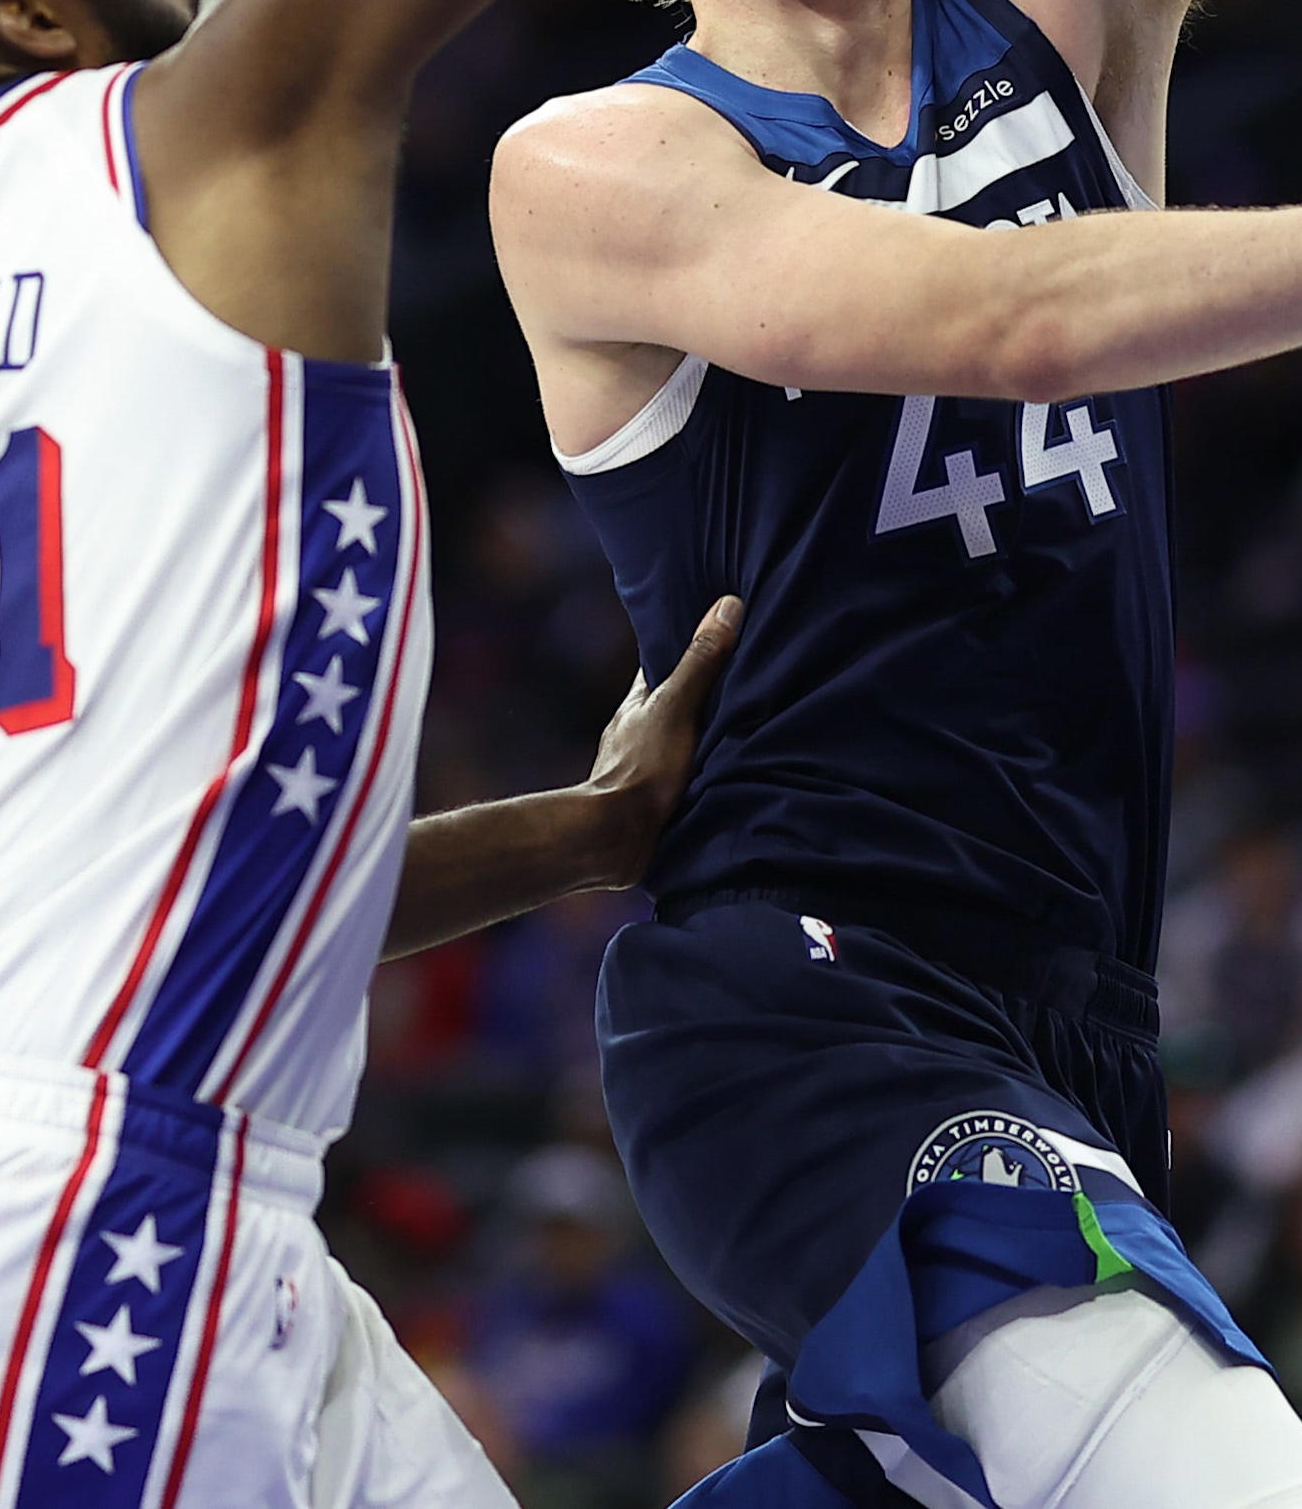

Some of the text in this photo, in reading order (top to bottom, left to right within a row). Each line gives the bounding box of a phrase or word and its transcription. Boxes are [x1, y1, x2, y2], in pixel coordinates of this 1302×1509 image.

[938, 78, 1015, 141] sezzle
[874, 394, 1120, 559] 44
[948, 1119, 1073, 1193] TIMBERWOLV
